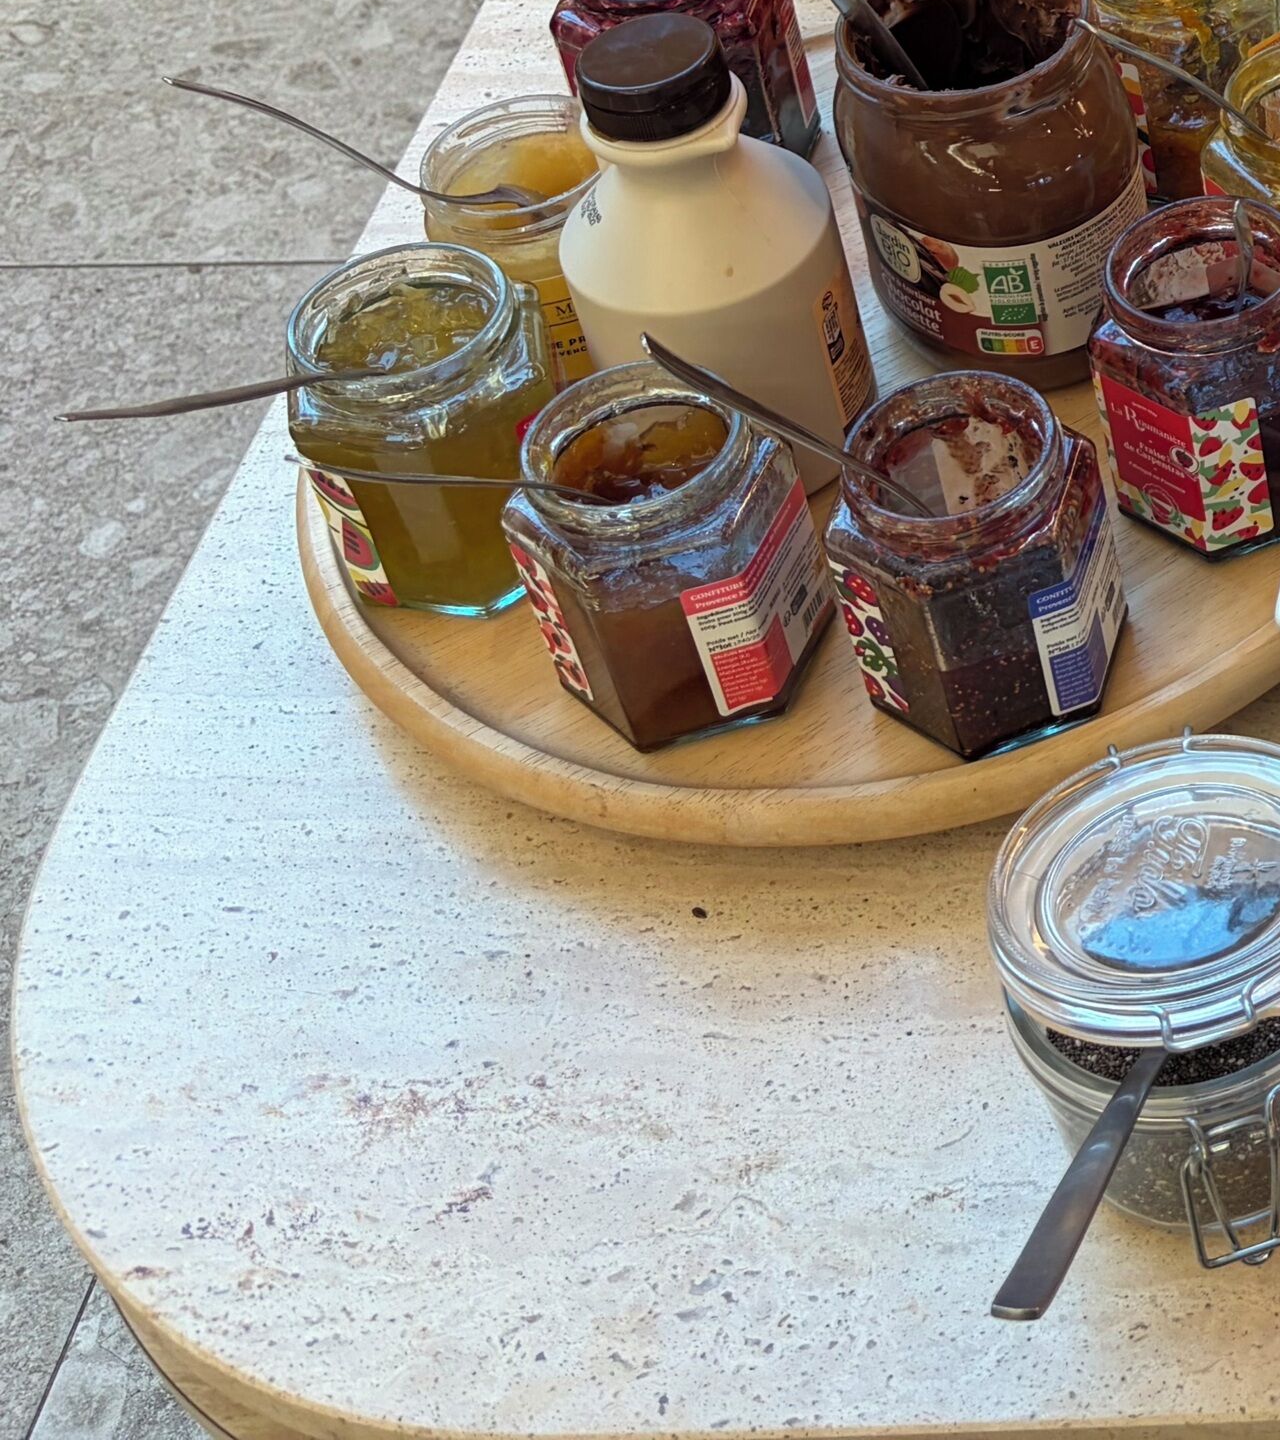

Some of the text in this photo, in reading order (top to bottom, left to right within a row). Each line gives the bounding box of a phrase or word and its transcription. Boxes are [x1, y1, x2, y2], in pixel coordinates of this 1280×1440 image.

[875, 222, 911, 254] Jardin
[990, 273, 1024, 293] AB
[1030, 340, 1039, 349] E
[1111, 402, 1123, 416] La
[1124, 405, 1186, 448] Roumanière
[695, 593, 739, 609] Provence
